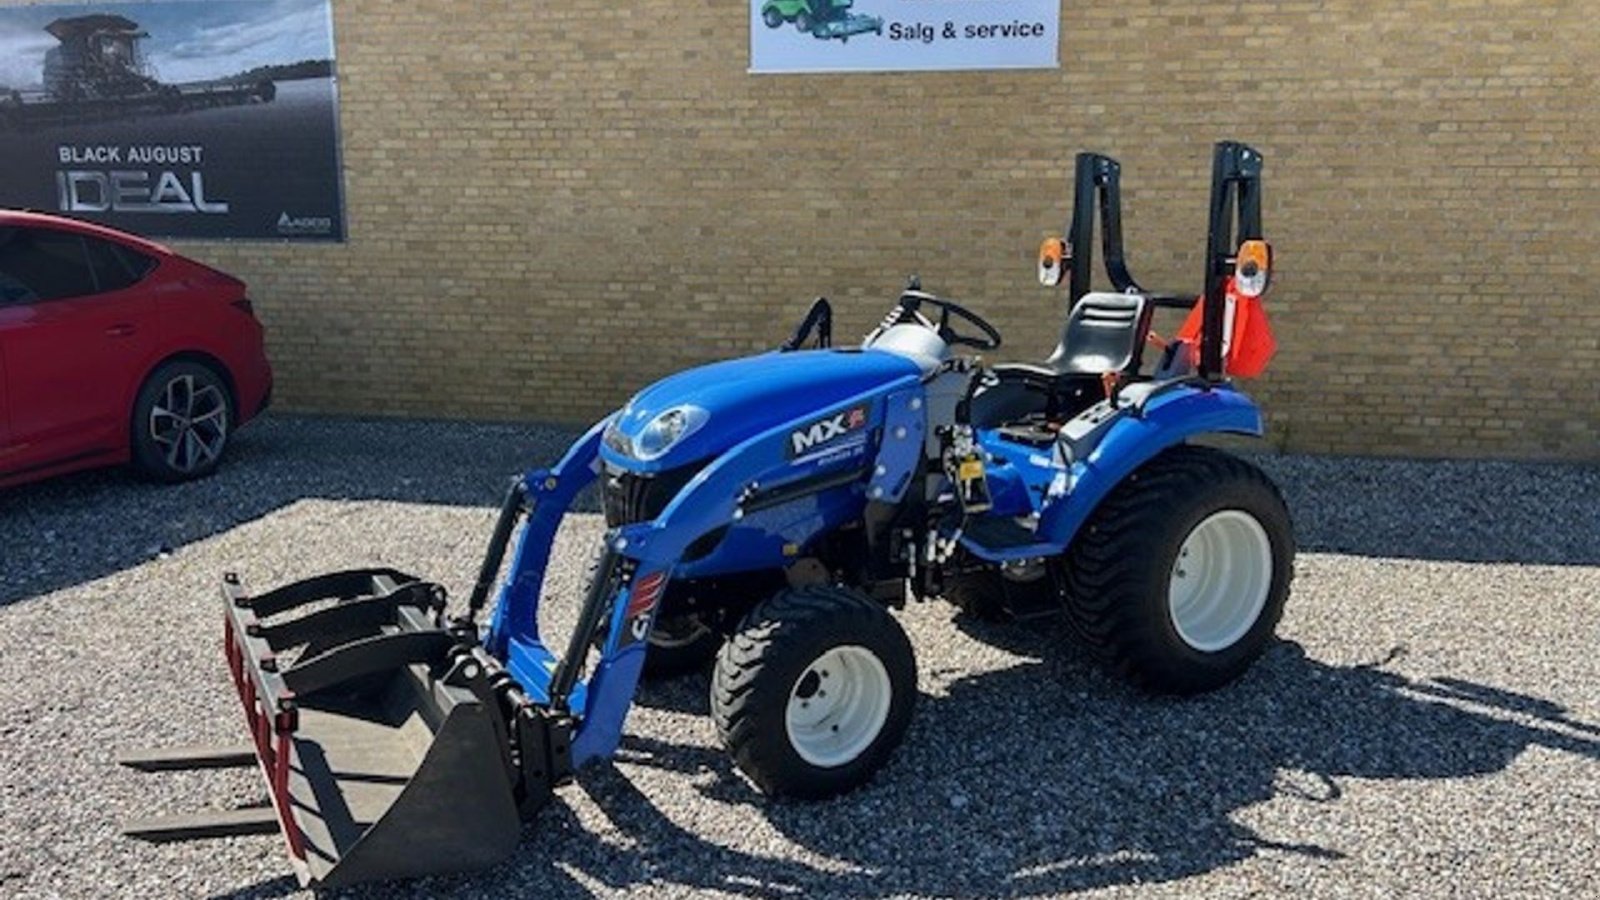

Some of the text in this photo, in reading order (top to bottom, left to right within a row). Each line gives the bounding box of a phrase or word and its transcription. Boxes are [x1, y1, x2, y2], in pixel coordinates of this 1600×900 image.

[889, 20, 1045, 43] Salg & service
[59, 146, 203, 163] BLACK AUGUST
[56, 170, 229, 213] IDEAL
